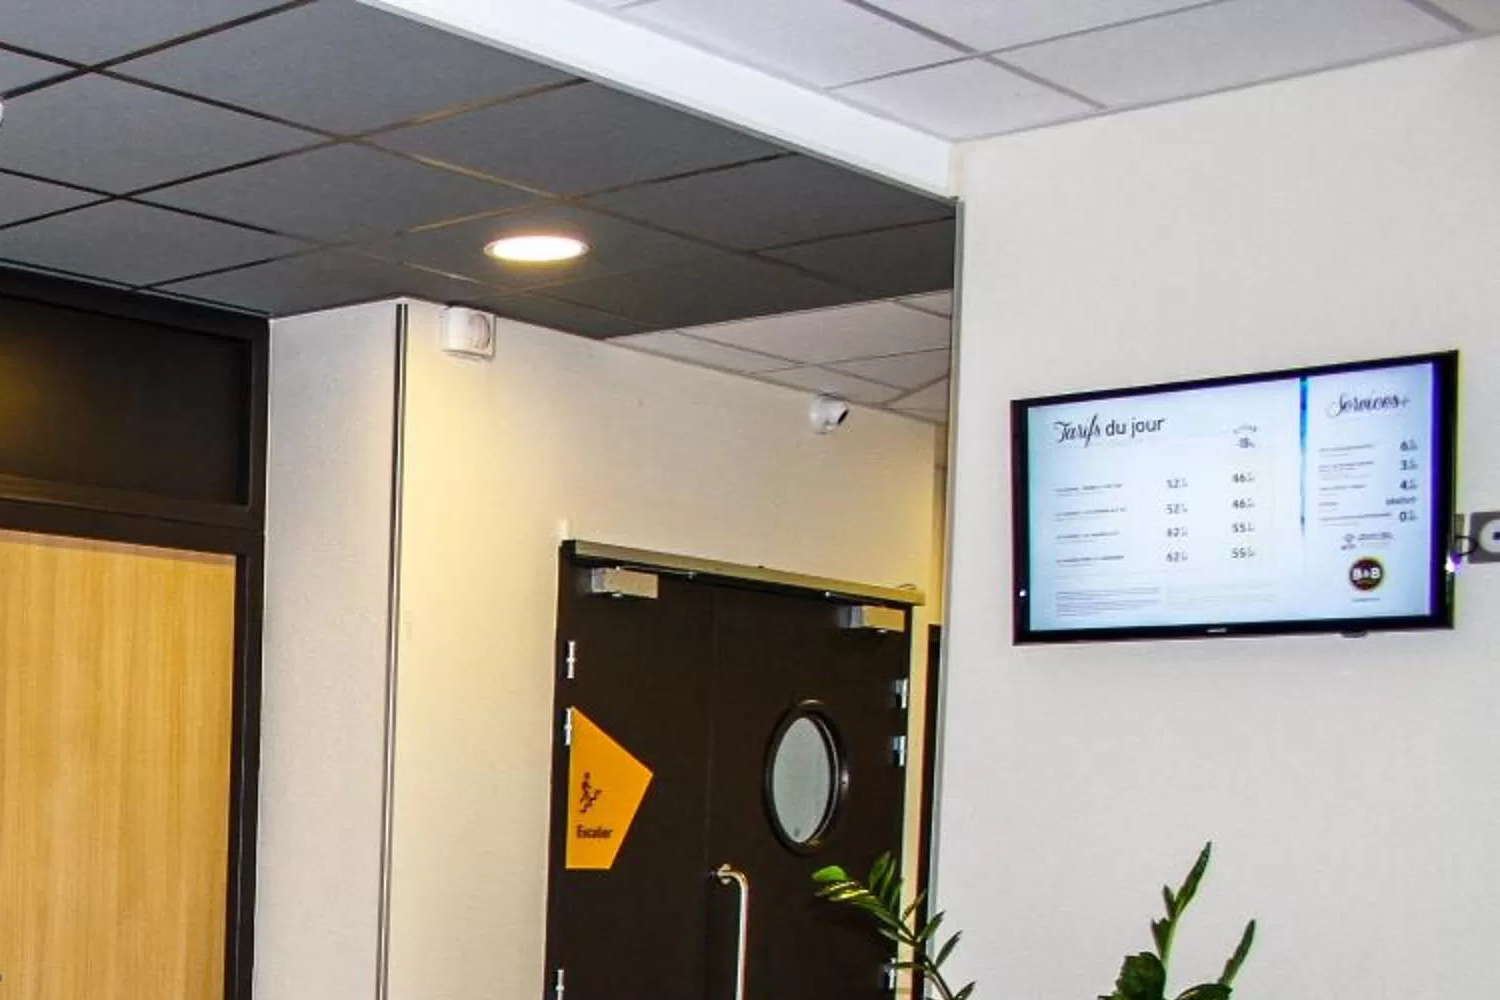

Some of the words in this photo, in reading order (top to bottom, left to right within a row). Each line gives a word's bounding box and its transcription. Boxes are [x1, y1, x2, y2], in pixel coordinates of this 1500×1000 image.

[1054, 413, 1101, 448] Tarifs
[1105, 418, 1127, 437] du
[1131, 416, 1166, 439] jour
